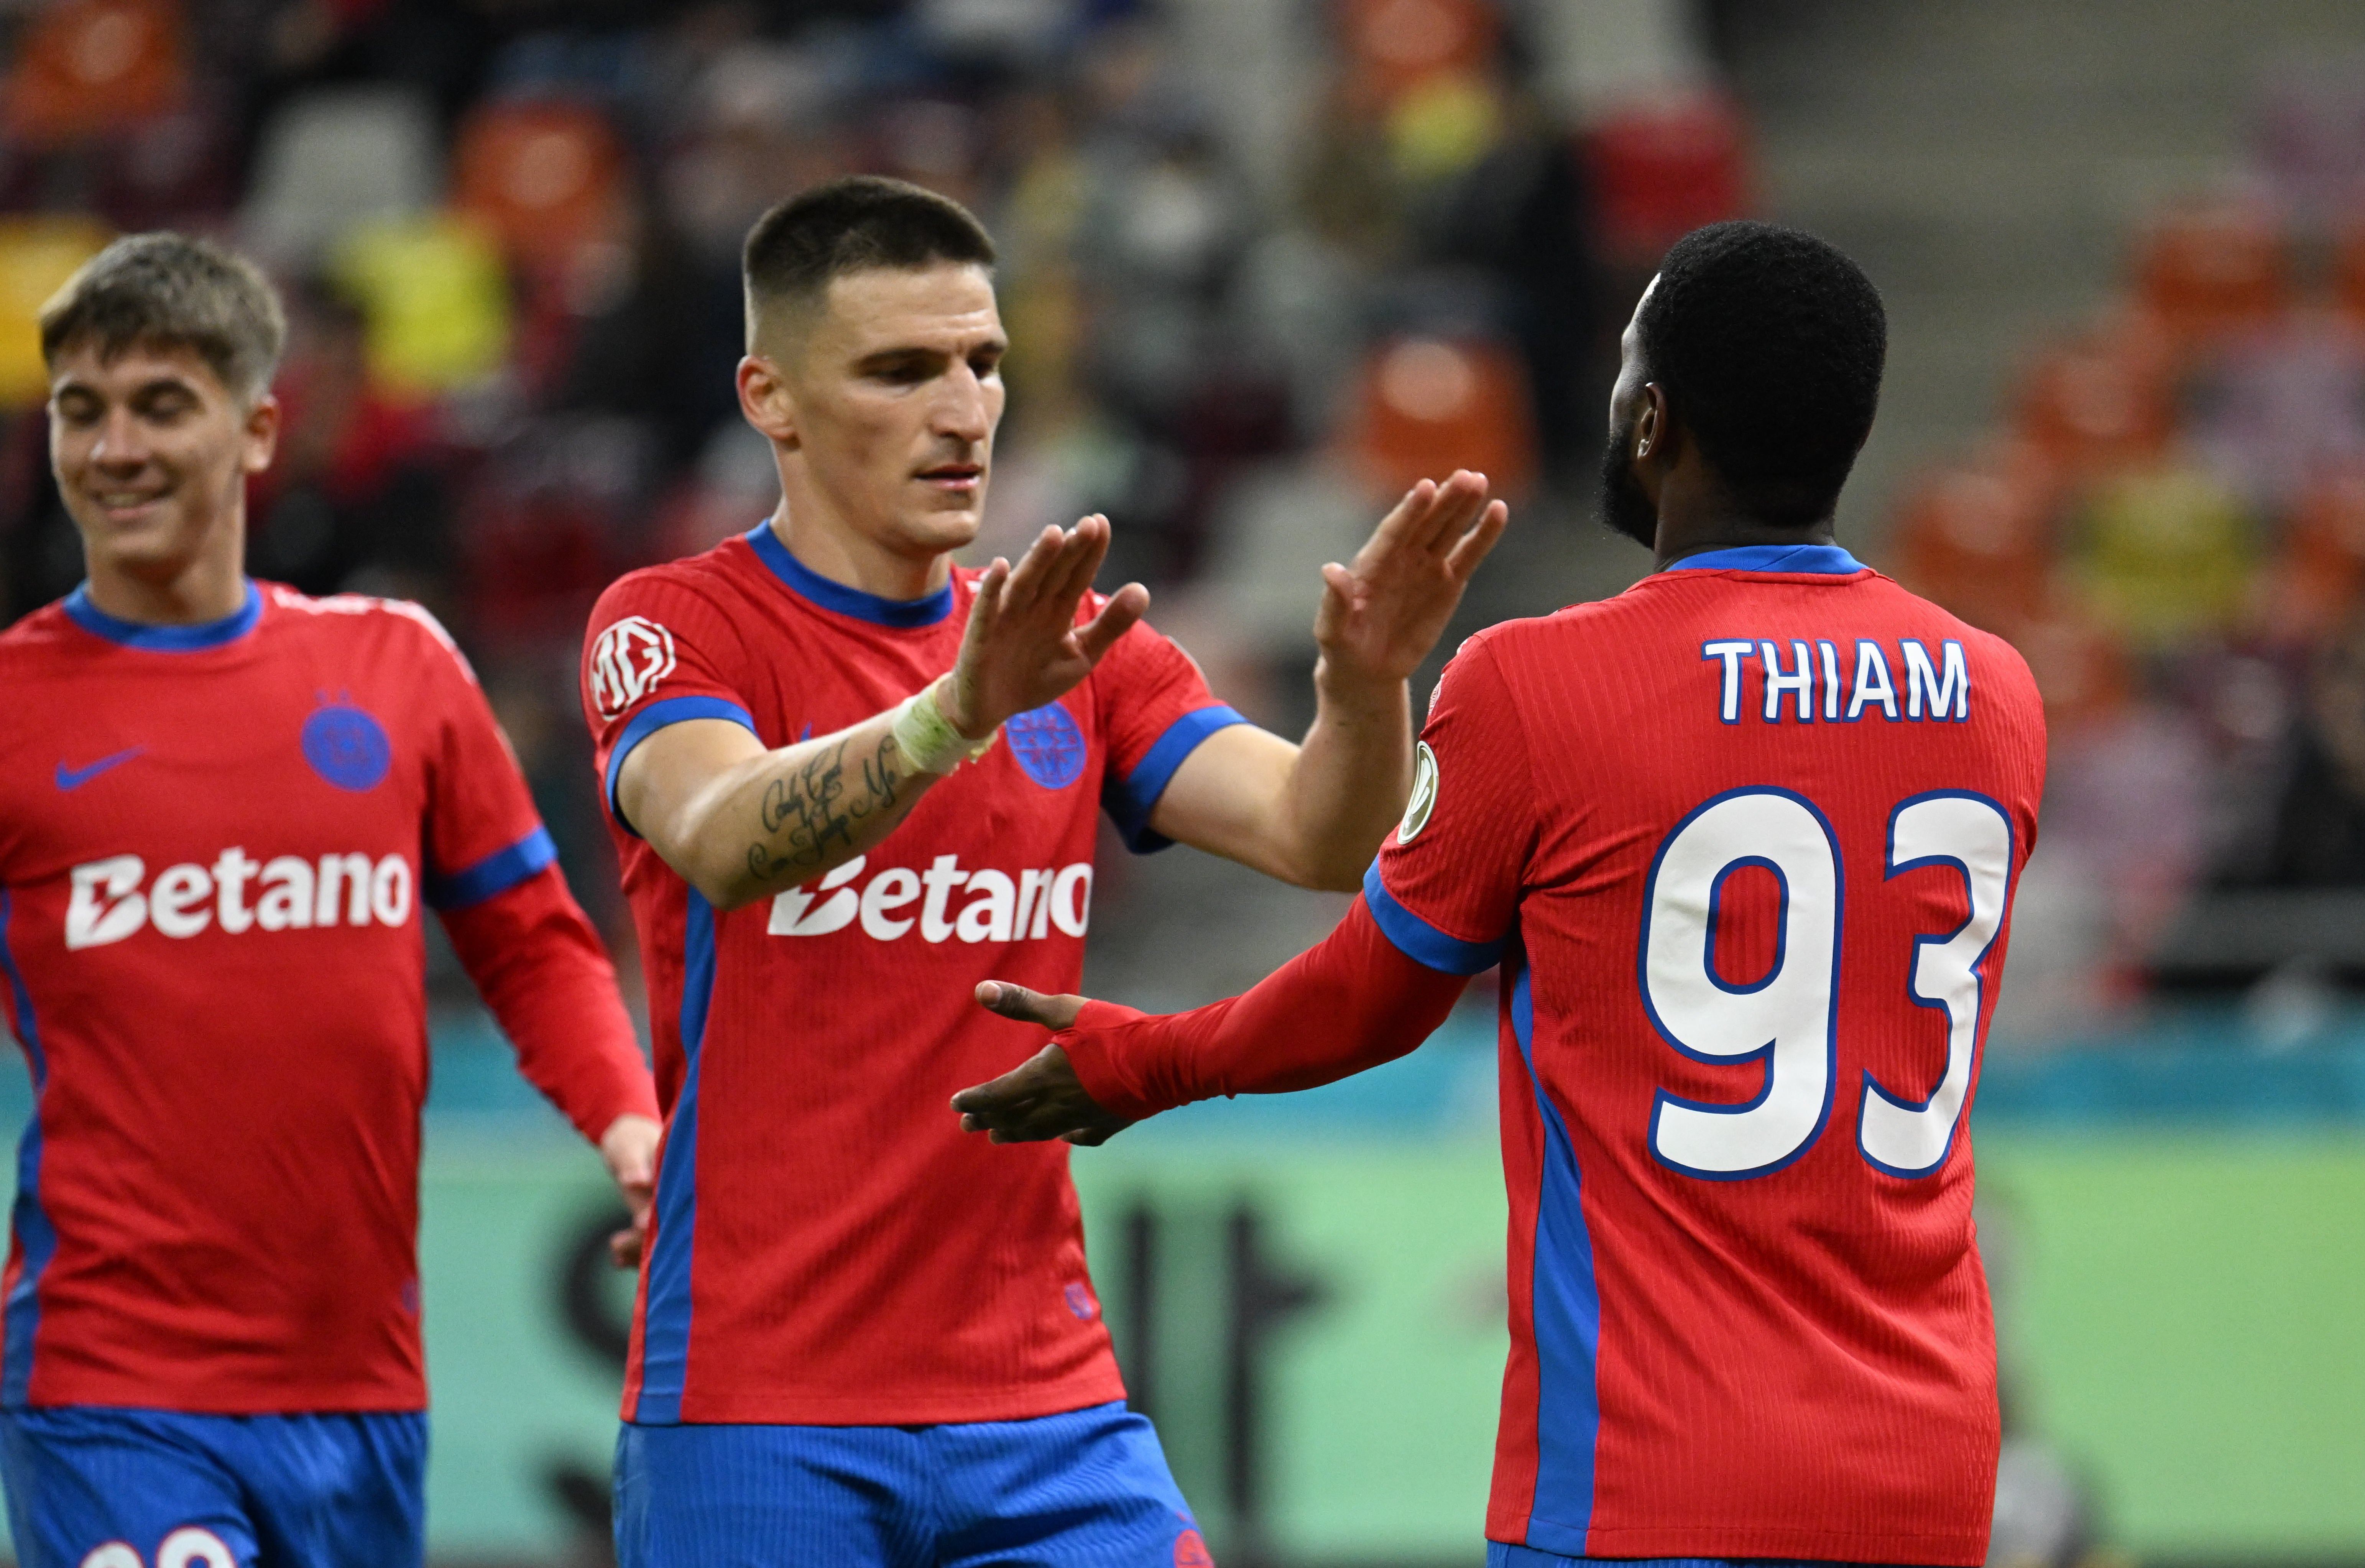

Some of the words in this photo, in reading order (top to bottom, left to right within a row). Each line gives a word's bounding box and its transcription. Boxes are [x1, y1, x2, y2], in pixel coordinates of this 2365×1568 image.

[592, 620, 664, 712] MG
[1701, 637, 1971, 725] THIAM
[65, 846, 411, 951] Betano
[767, 854, 1093, 943] Betano
[1637, 784, 2015, 1182] 93
